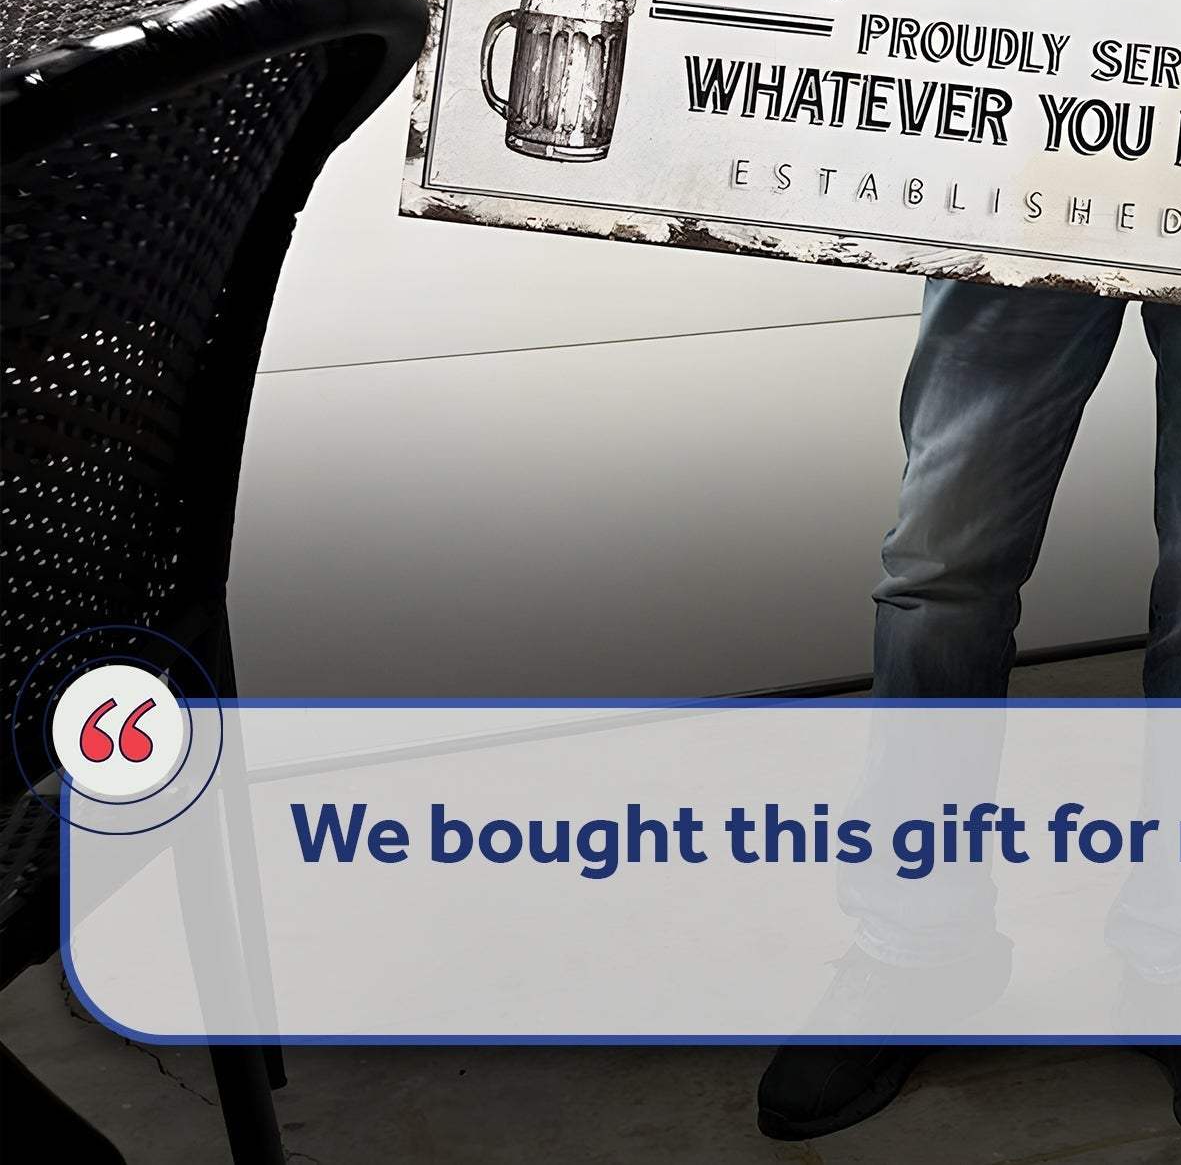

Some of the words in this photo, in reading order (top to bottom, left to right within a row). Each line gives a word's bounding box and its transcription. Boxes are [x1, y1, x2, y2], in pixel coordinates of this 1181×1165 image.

[857, 14, 1071, 76] PROUDLY
[684, 55, 1013, 146] WHATEVER
[1038, 94, 1155, 161] YOU
